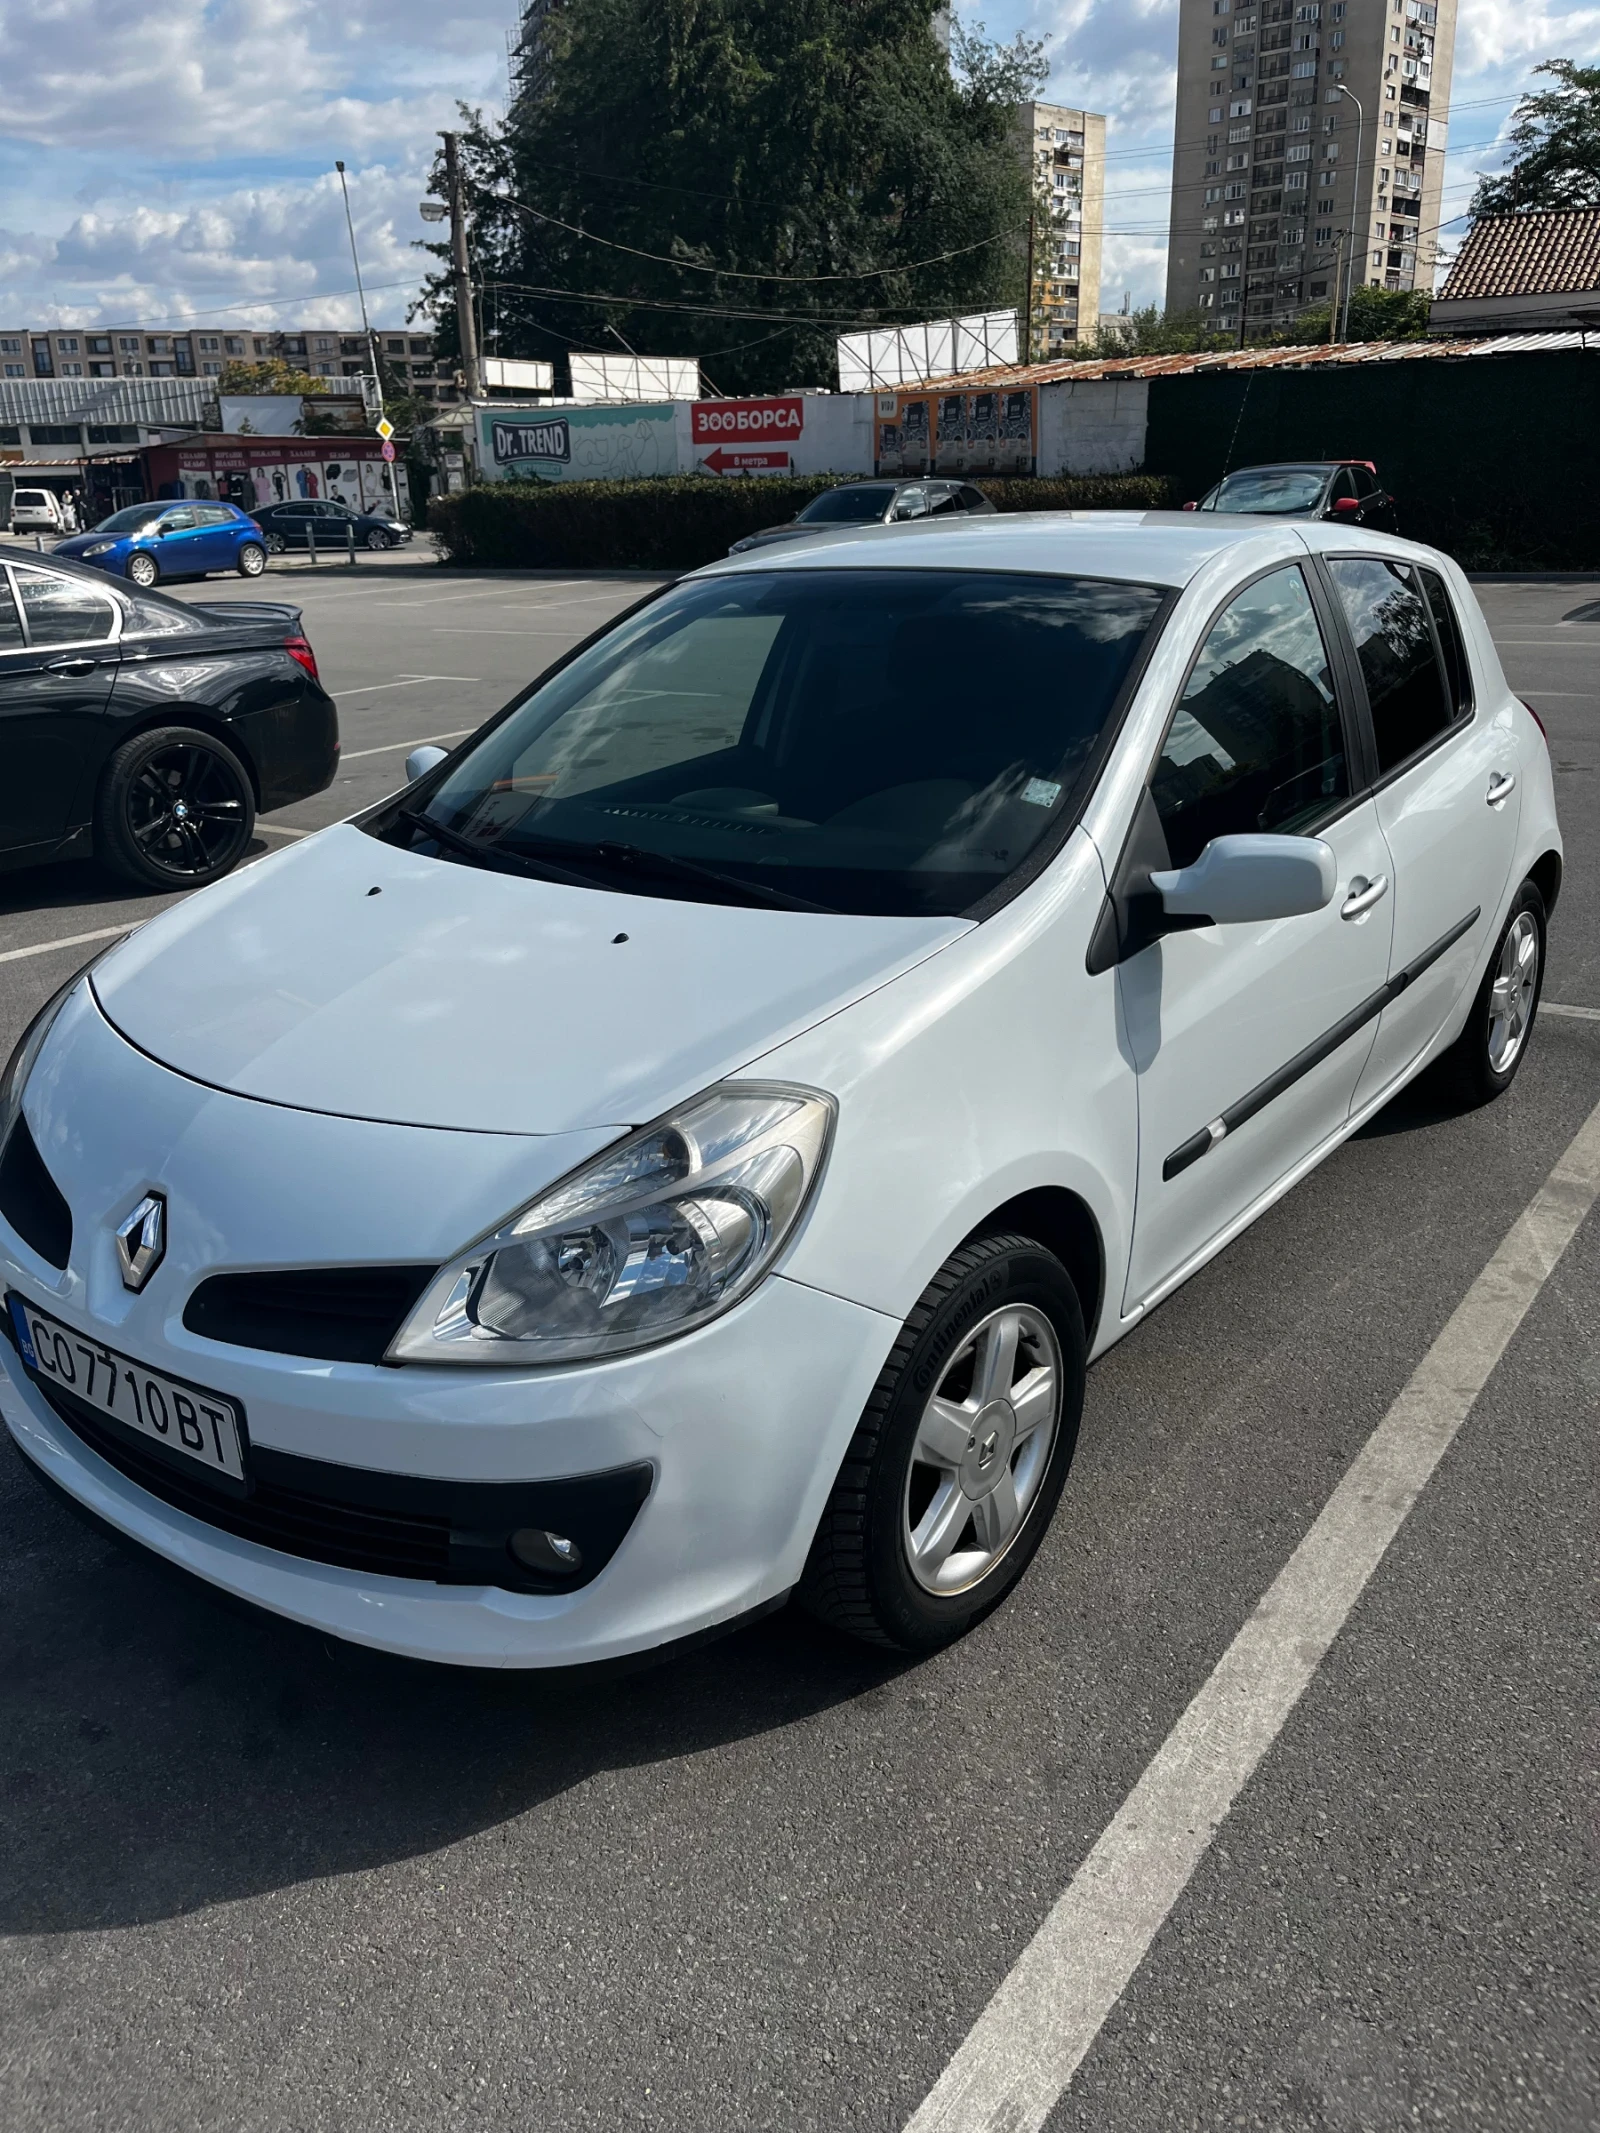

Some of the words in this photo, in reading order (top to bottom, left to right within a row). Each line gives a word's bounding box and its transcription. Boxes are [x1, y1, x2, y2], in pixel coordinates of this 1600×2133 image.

[697, 408, 801, 432] ЗООБОРСА
[495, 426, 518, 457] Dr.
[518, 425, 565, 456] TREND
[741, 457, 768, 468] метра
[21, 1338, 35, 1358] BG
[912, 1277, 990, 1393] Continental
[31, 1319, 226, 1464] CO7710BT
